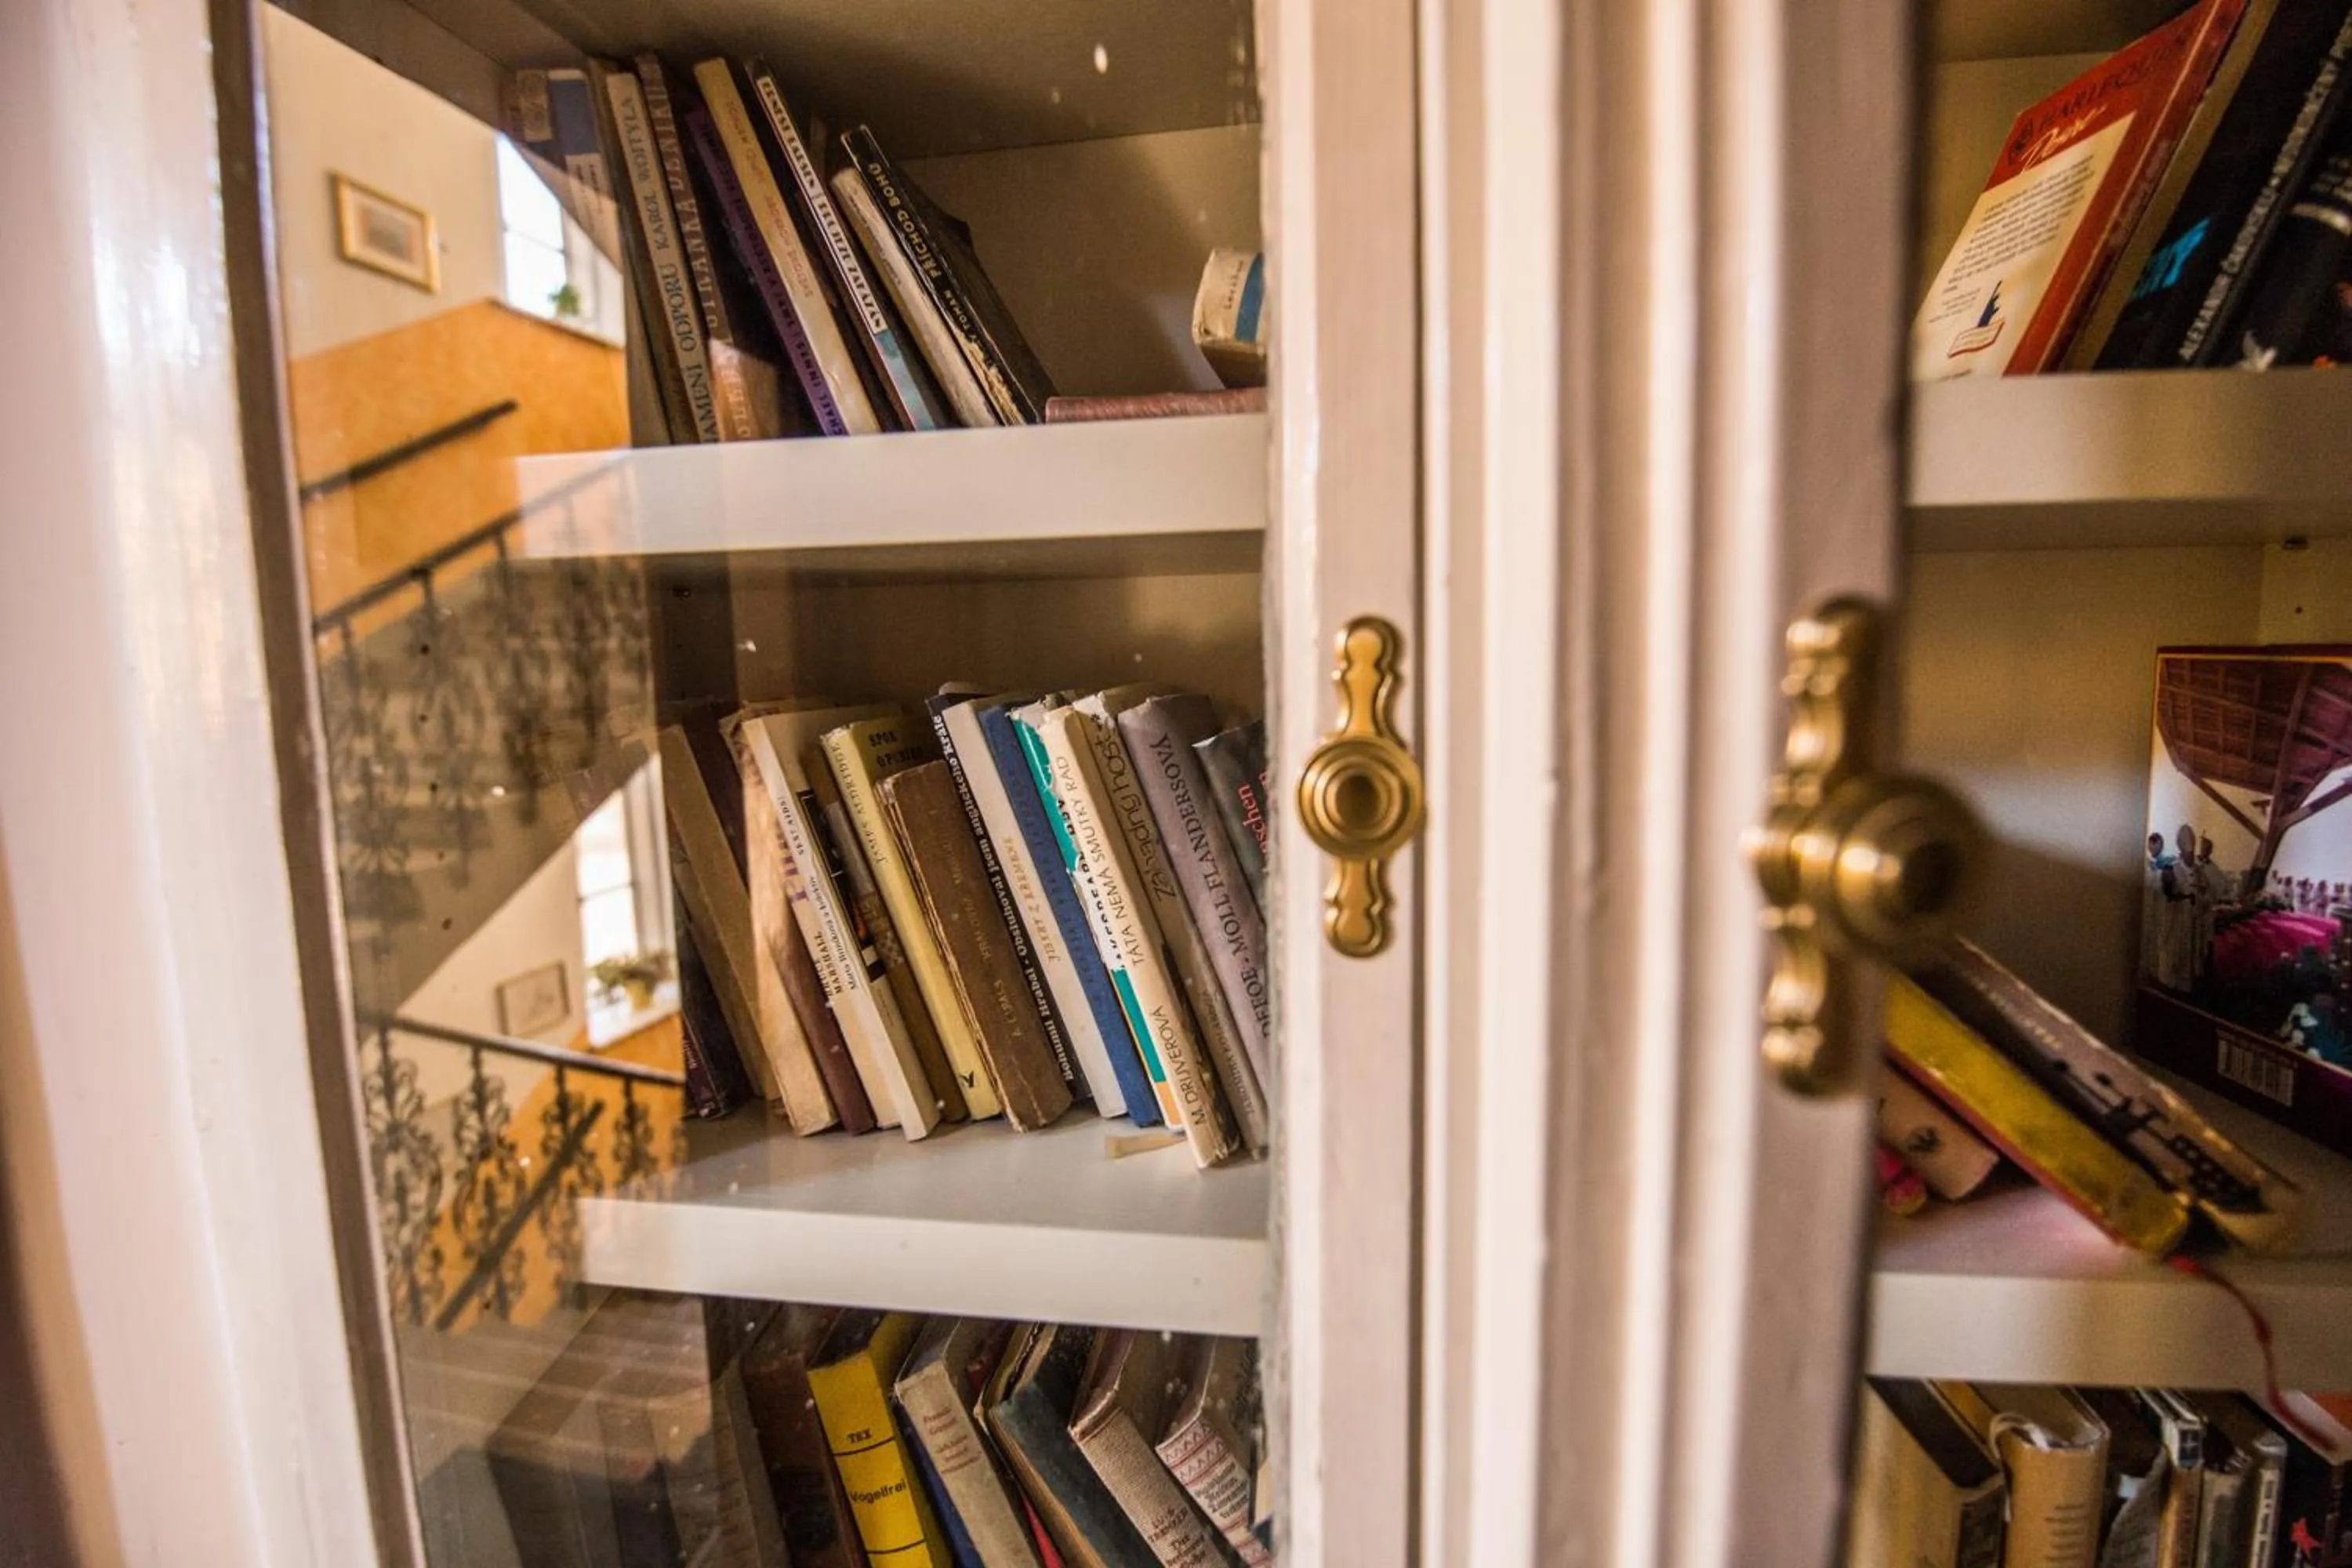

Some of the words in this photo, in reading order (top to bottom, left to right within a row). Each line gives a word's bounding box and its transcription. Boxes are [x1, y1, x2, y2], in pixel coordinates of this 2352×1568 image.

[644, 188, 669, 250] KAROL
[894, 209, 940, 278] PŘÍCHOD
[659, 263, 698, 352] ODPORU
[945, 290, 970, 329] TOMAN
[830, 742, 866, 815] ALDRIDGE
[1095, 730, 1129, 794] host
[862, 822, 887, 863] JAMES
[1072, 797, 1105, 863] SMUTKY
[1150, 732, 1220, 891] FLANDERSOVÁ
[980, 837, 1000, 873] jsem
[991, 875, 1028, 959] Obsluhoval
[1214, 897, 1248, 956] MOLL
[815, 930, 844, 994] MARSHALL
[1025, 967, 1051, 1018] Hrabal
[851, 1479, 906, 1504] Vogelfrei
